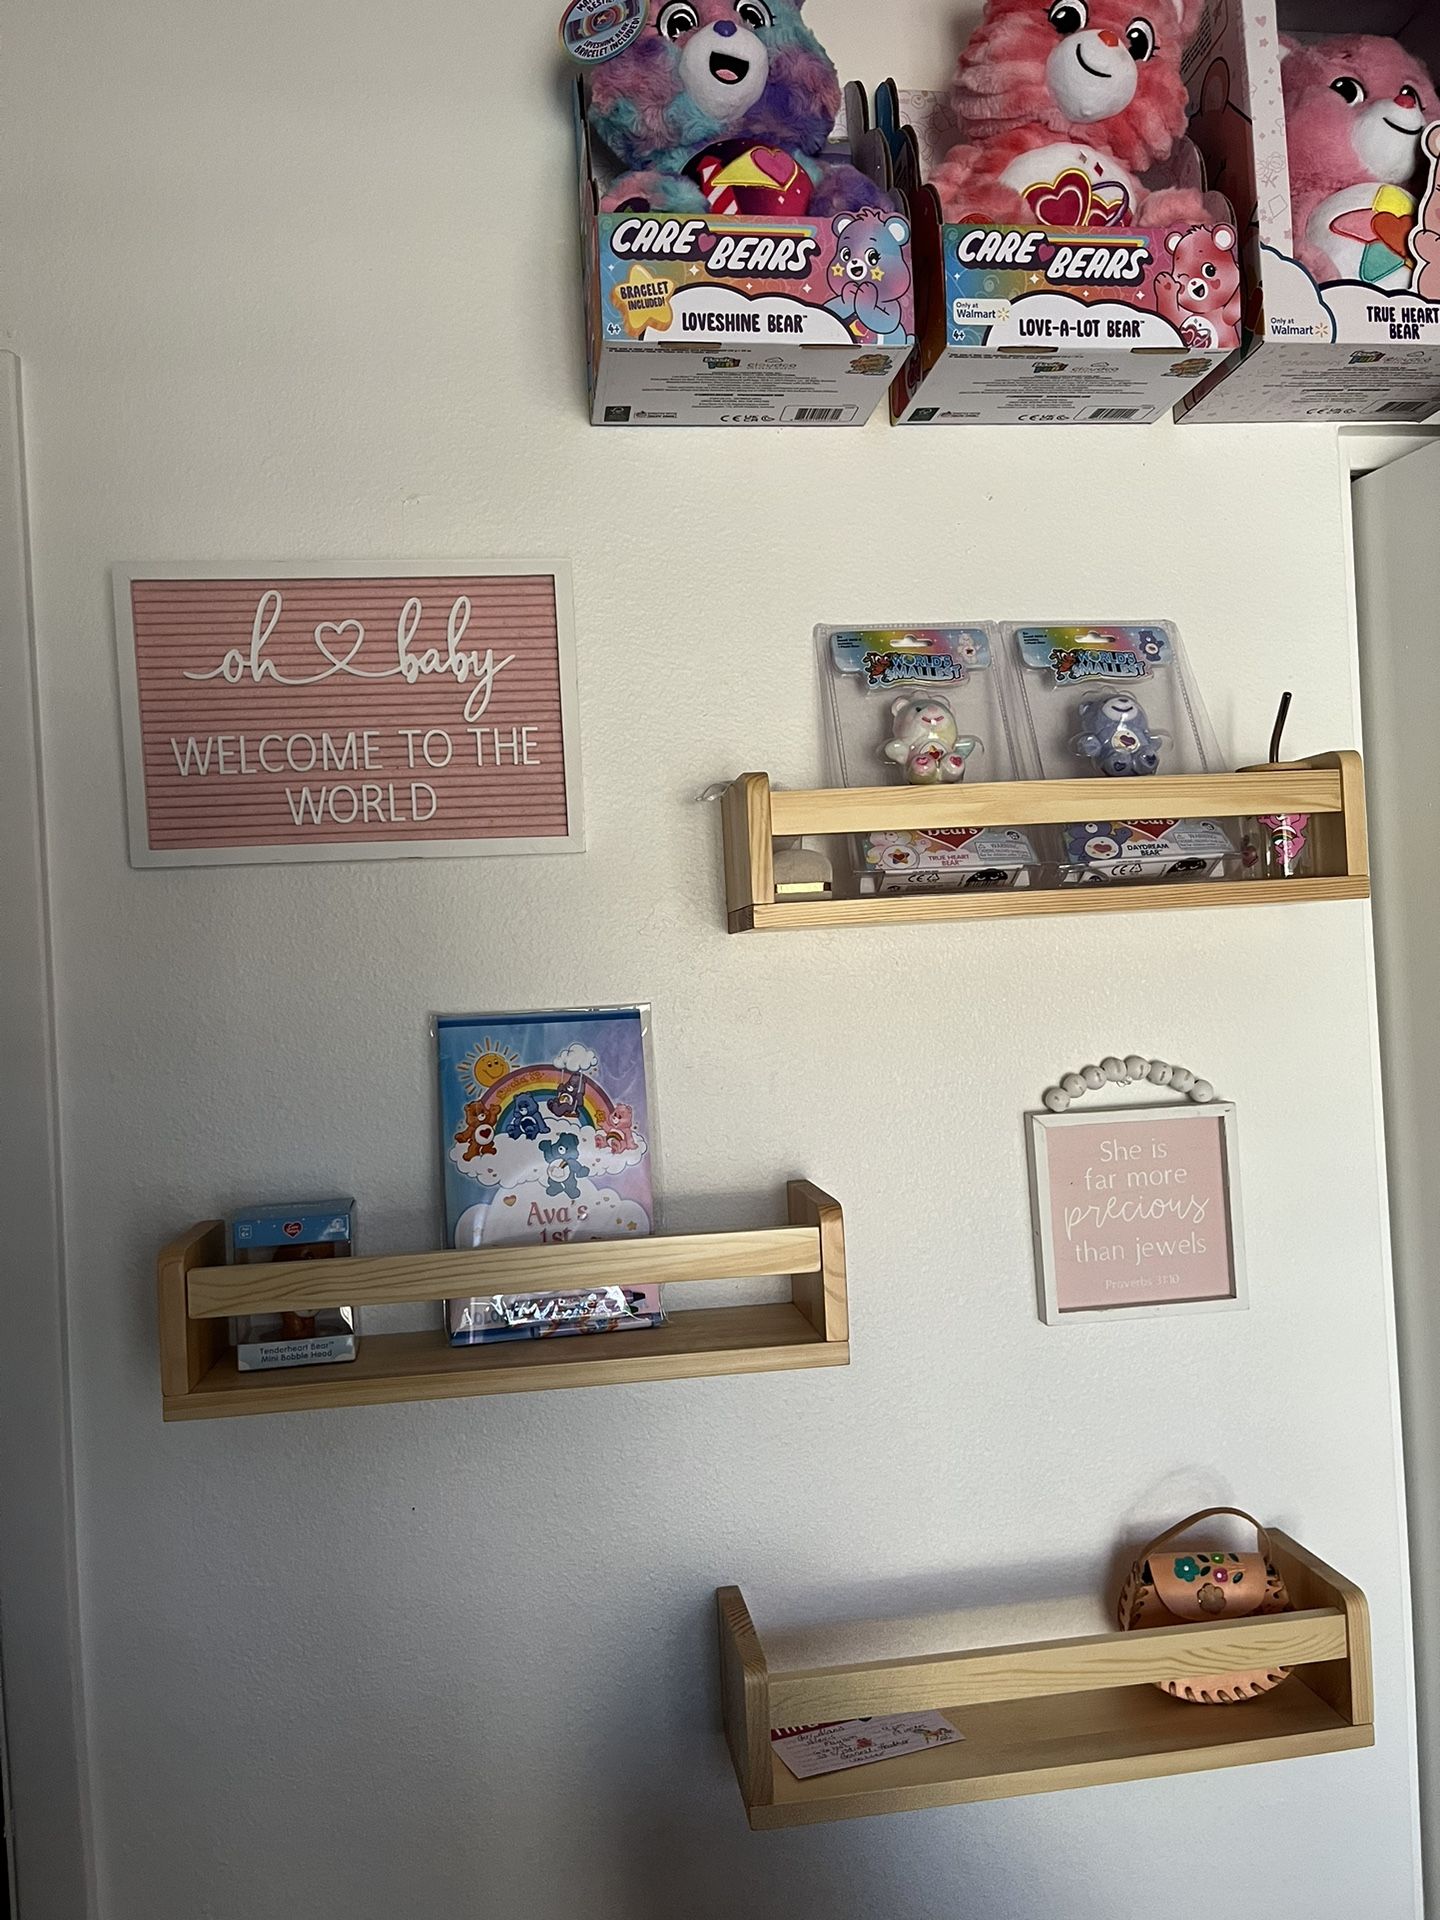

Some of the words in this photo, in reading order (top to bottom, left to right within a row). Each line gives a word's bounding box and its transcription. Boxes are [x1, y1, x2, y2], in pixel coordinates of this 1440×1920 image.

[611, 219, 707, 254] CARE
[706, 237, 818, 272] BEARS
[957, 230, 1046, 264] CARE
[1047, 247, 1150, 280] BEARS
[620, 281, 669, 299] BRACELET
[628, 298, 666, 311] INCLUDED!
[956, 302, 971, 311] Only
[972, 302, 980, 310] at
[956, 307, 997, 320] Walmart
[1270, 317, 1287, 326] Only
[1366, 306, 1397, 323] TRUE
[1401, 307, 1440, 324] HEART
[606, 322, 621, 335] 4+
[682, 312, 761, 333] LOVESHINE
[767, 314, 804, 333] BEAR
[1019, 318, 1101, 338] LOVE-A-LOT
[1107, 319, 1142, 339] BEAR
[1271, 324, 1314, 336] Walmart
[1389, 323, 1421, 340] BEAR
[182, 589, 280, 685] oh
[398, 596, 516, 723] baby
[885, 664, 961, 681] SMALLEST
[1071, 661, 1145, 677] SMALLEST
[170, 730, 384, 777] WELCOME
[398, 728, 454, 769] TO
[466, 726, 542, 767] THE
[284, 782, 438, 827] WORLD
[1126, 843, 1170, 851] DAYDREAM
[1099, 1139, 1142, 1162] She
[1151, 1137, 1168, 1159] is
[1084, 1167, 1116, 1191] far
[1126, 1167, 1188, 1188] more
[526, 1199, 589, 1226] Ava's
[1064, 1194, 1211, 1241] precious
[539, 1227, 573, 1243] 1st
[1075, 1240, 1125, 1263] than
[1134, 1231, 1208, 1266] jewels
[1105, 1277, 1153, 1291] Proverbs
[260, 1345, 309, 1356] Tenderheart
[260, 1355, 279, 1364] Mini
[280, 1351, 309, 1362] Bobble
[310, 1349, 333, 1358] Head
